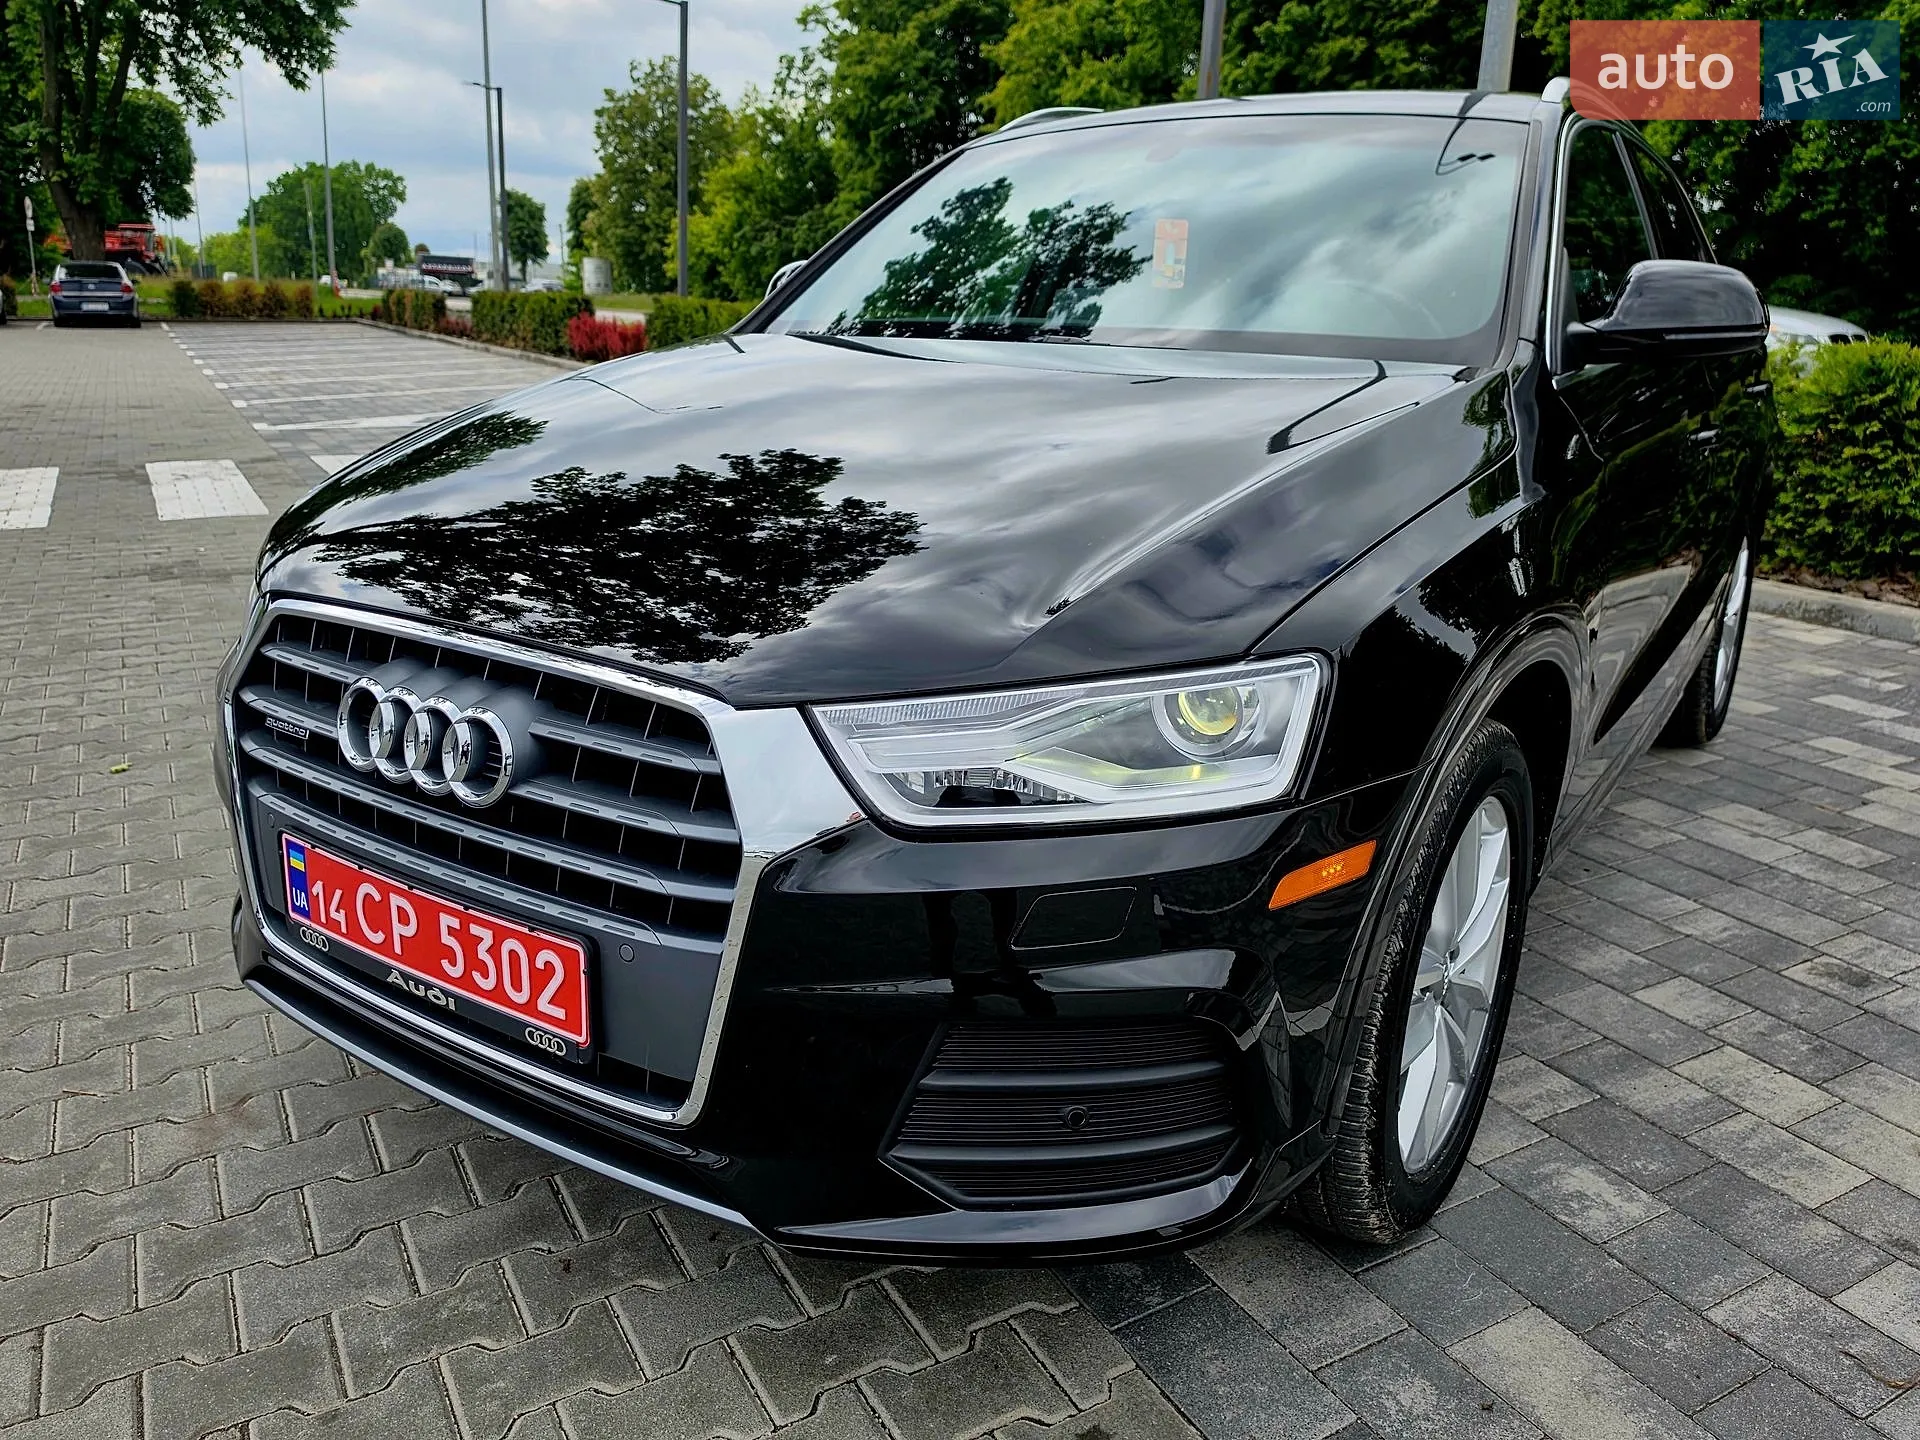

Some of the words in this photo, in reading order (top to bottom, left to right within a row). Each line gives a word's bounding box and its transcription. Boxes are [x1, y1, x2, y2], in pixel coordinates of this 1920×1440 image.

[265, 717, 308, 738] quattro
[292, 887, 308, 911] UA
[438, 912, 566, 1021] 5302
[386, 969, 456, 1011] Audi
